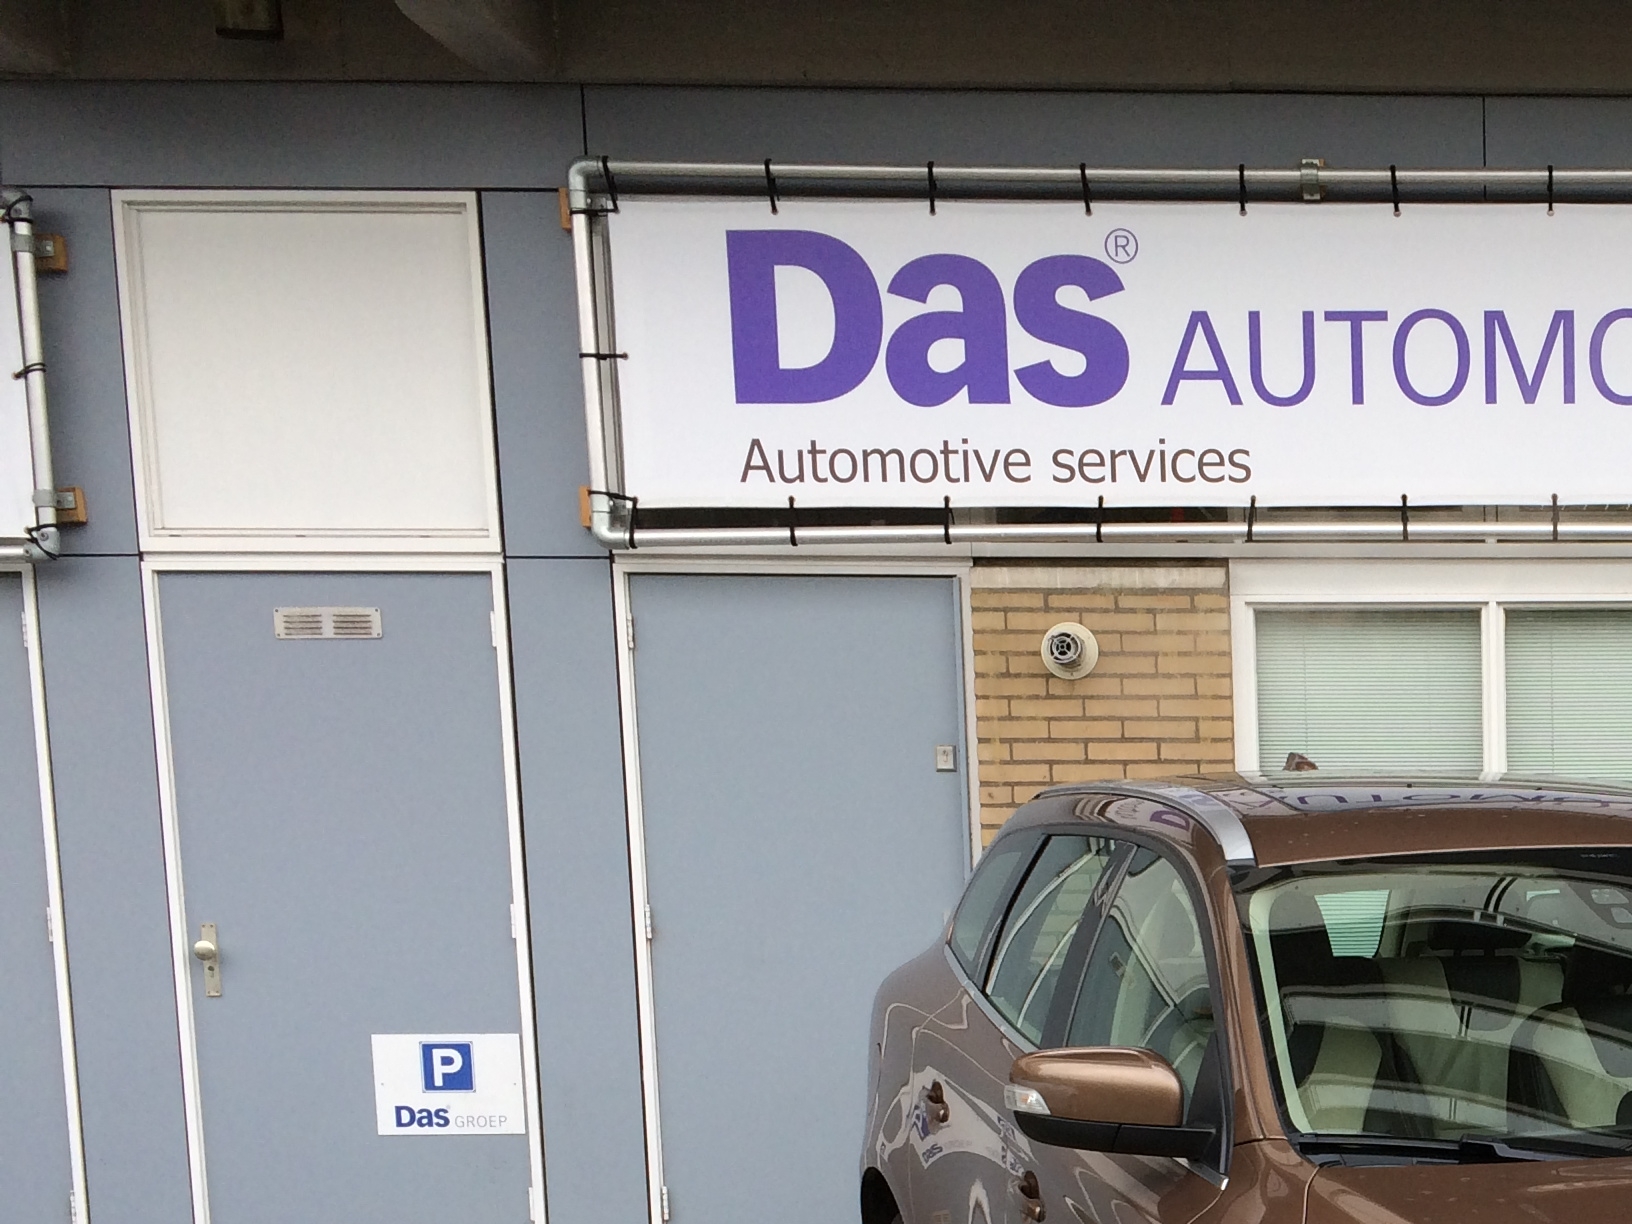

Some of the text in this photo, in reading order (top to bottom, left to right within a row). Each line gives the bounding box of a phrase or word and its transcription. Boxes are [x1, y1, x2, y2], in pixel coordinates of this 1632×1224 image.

[726, 229, 1131, 408] Das
[740, 437, 1253, 484] Automotive services
[432, 1048, 464, 1087] P
[394, 1105, 508, 1128] Das GROEP
